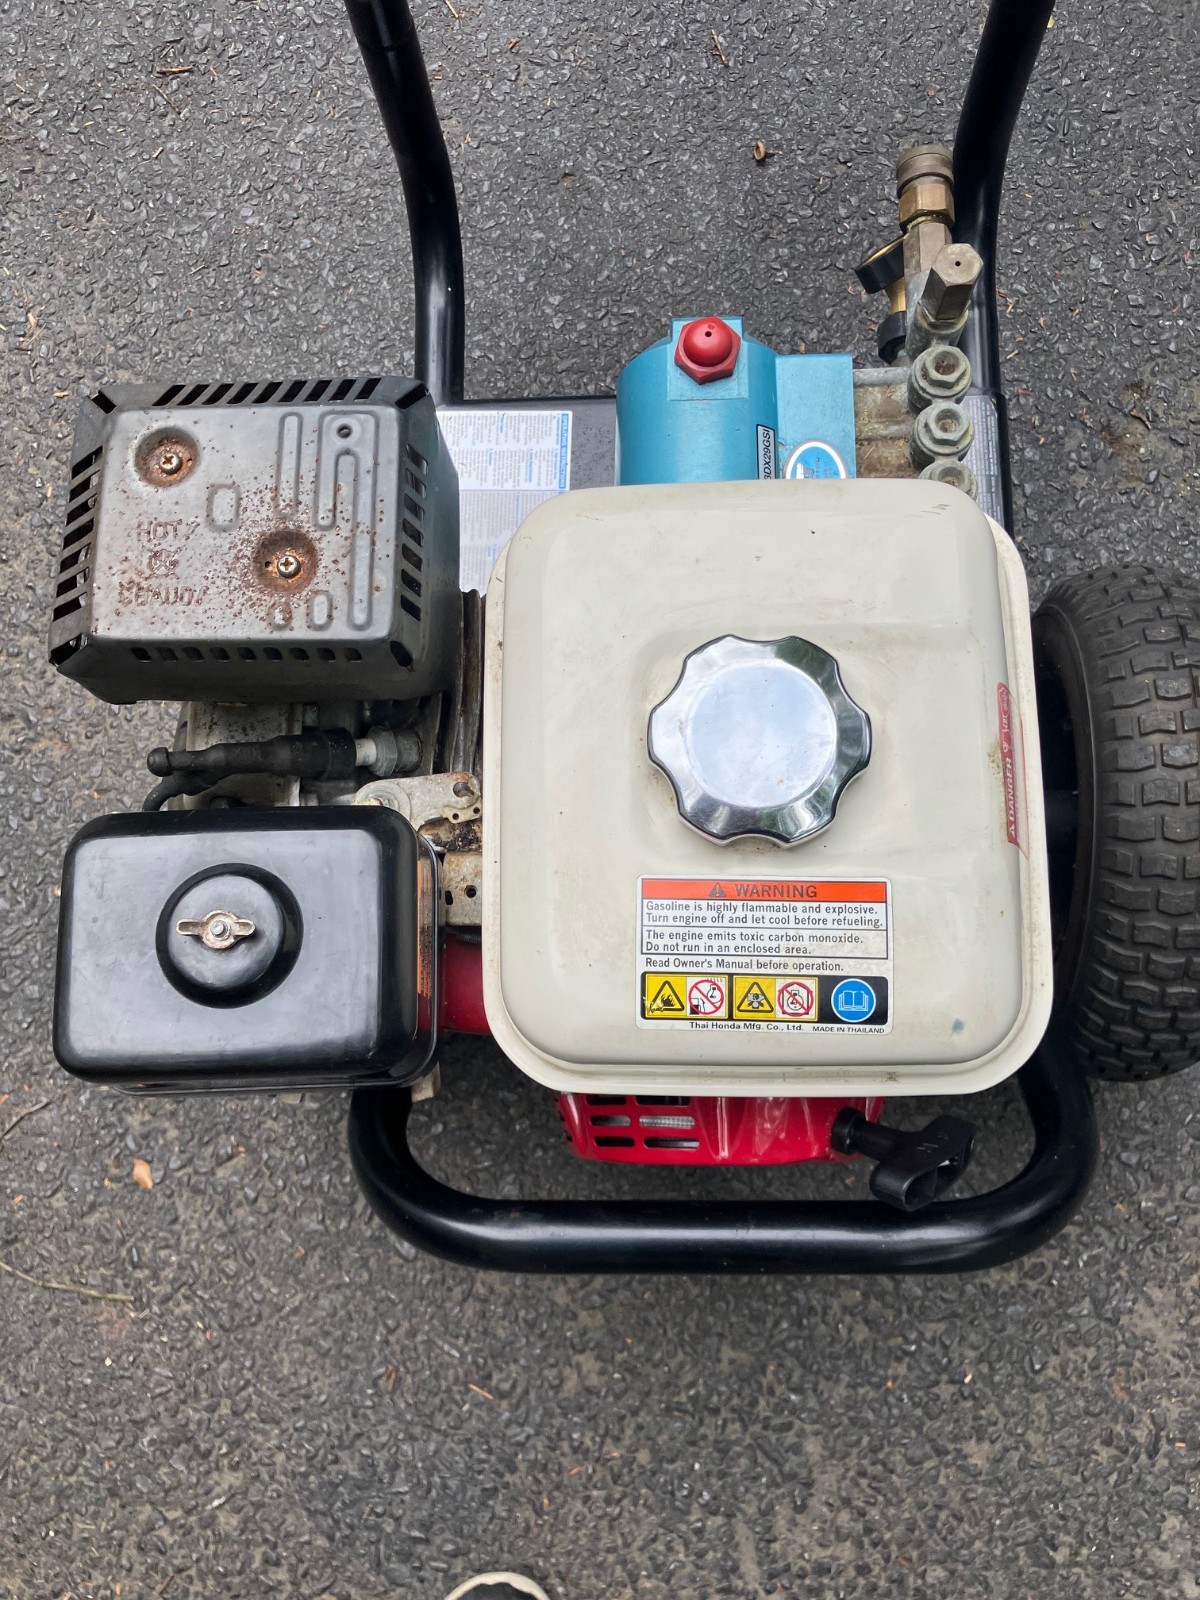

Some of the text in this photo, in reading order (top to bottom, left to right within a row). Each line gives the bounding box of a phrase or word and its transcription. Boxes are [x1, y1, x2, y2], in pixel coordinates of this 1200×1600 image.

[1005, 757, 1015, 822] DANGER
[735, 884, 818, 899] WARNING
[646, 901, 878, 916] Gasoline is highly flammable and explosive.
[646, 913, 883, 928] Turn engine off and let cool before refueling.
[646, 930, 863, 943] The engine emits toxic carbon monoxide.
[646, 942, 812, 954] Do not run in an enclosed area.
[646, 957, 844, 972] Read Owner's Manual before operation.
[689, 1021, 804, 1031] Thai Honda Mfg. Co., Ltd.
[812, 1025, 835, 1033] MADE
[847, 1026, 885, 1034] THAILAND
